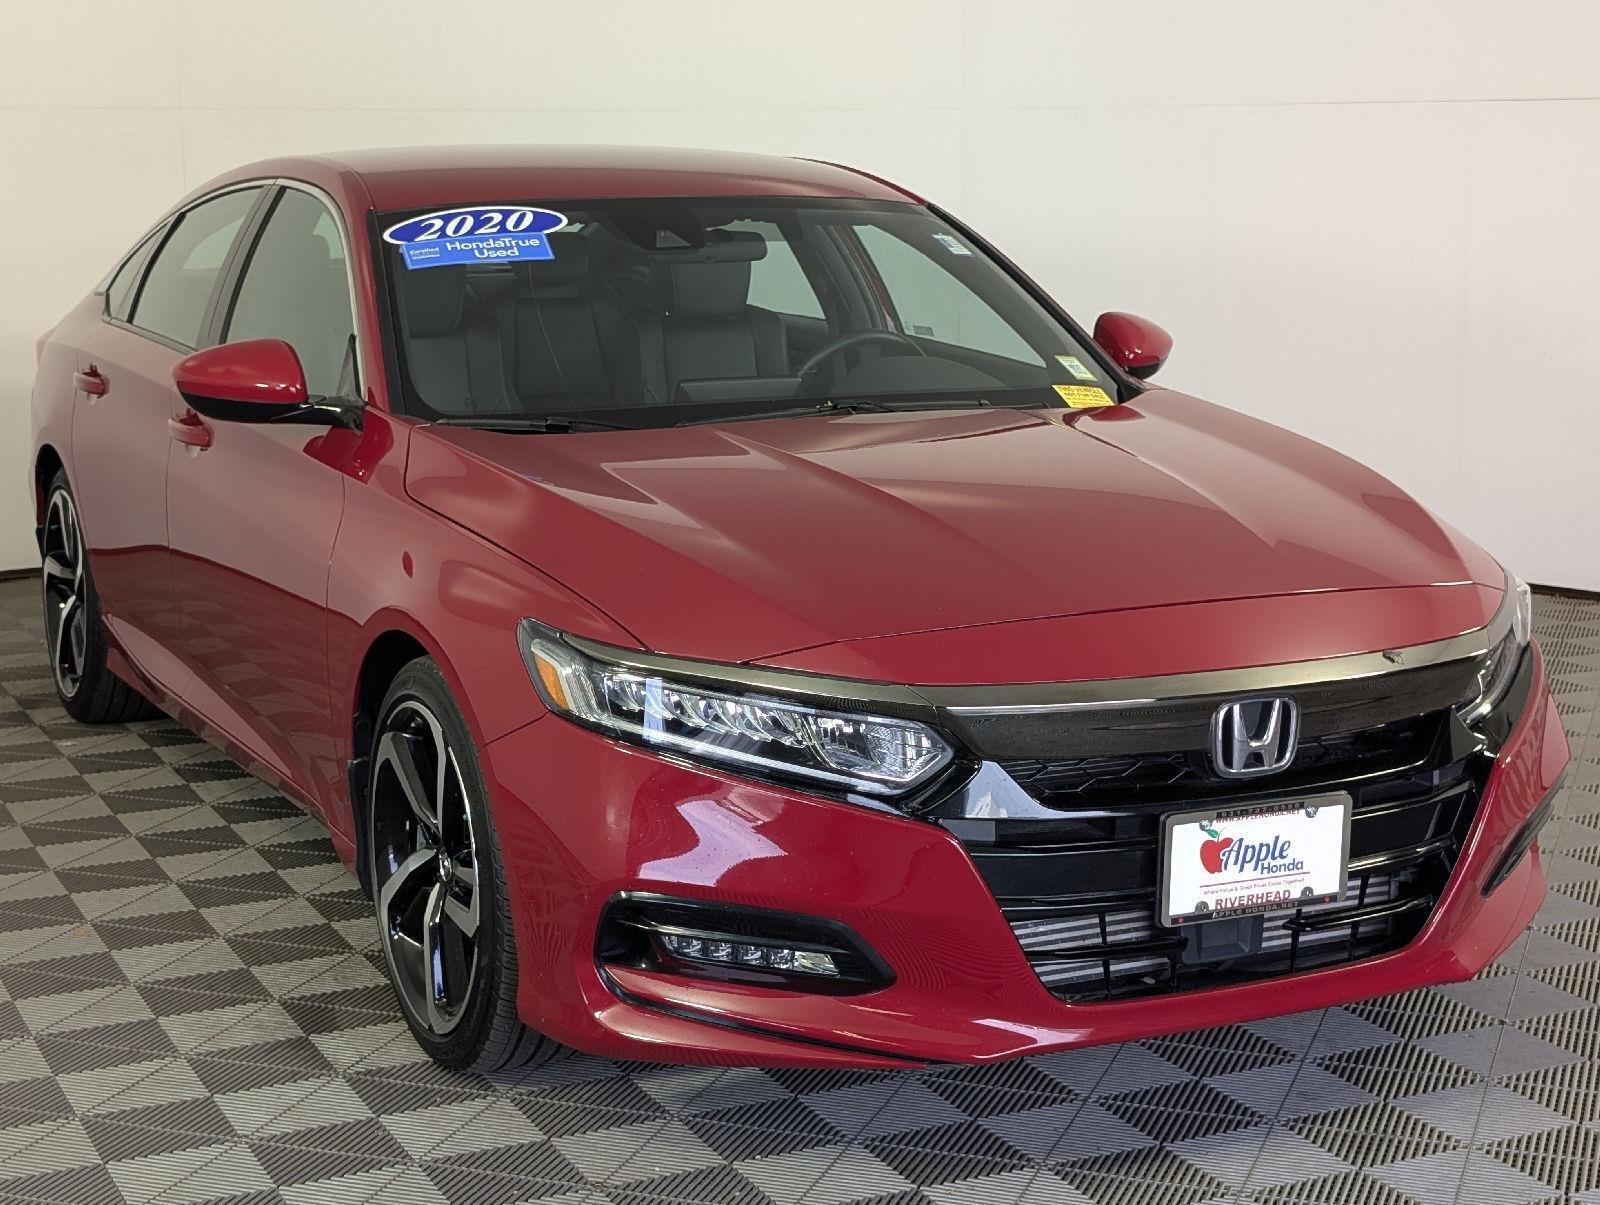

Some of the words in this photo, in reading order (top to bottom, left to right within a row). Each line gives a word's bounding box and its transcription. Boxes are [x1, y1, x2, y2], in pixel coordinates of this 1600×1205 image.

[414, 210, 534, 242] 2020
[445, 237, 540, 252] HondaTrue
[474, 247, 520, 259] Used
[1221, 834, 1291, 874] Apple
[1260, 858, 1304, 875] Honda
[1214, 889, 1291, 910] RIVERHEAD
[1212, 908, 1243, 919] APPLE
[1245, 901, 1299, 914] HONDA.NET
